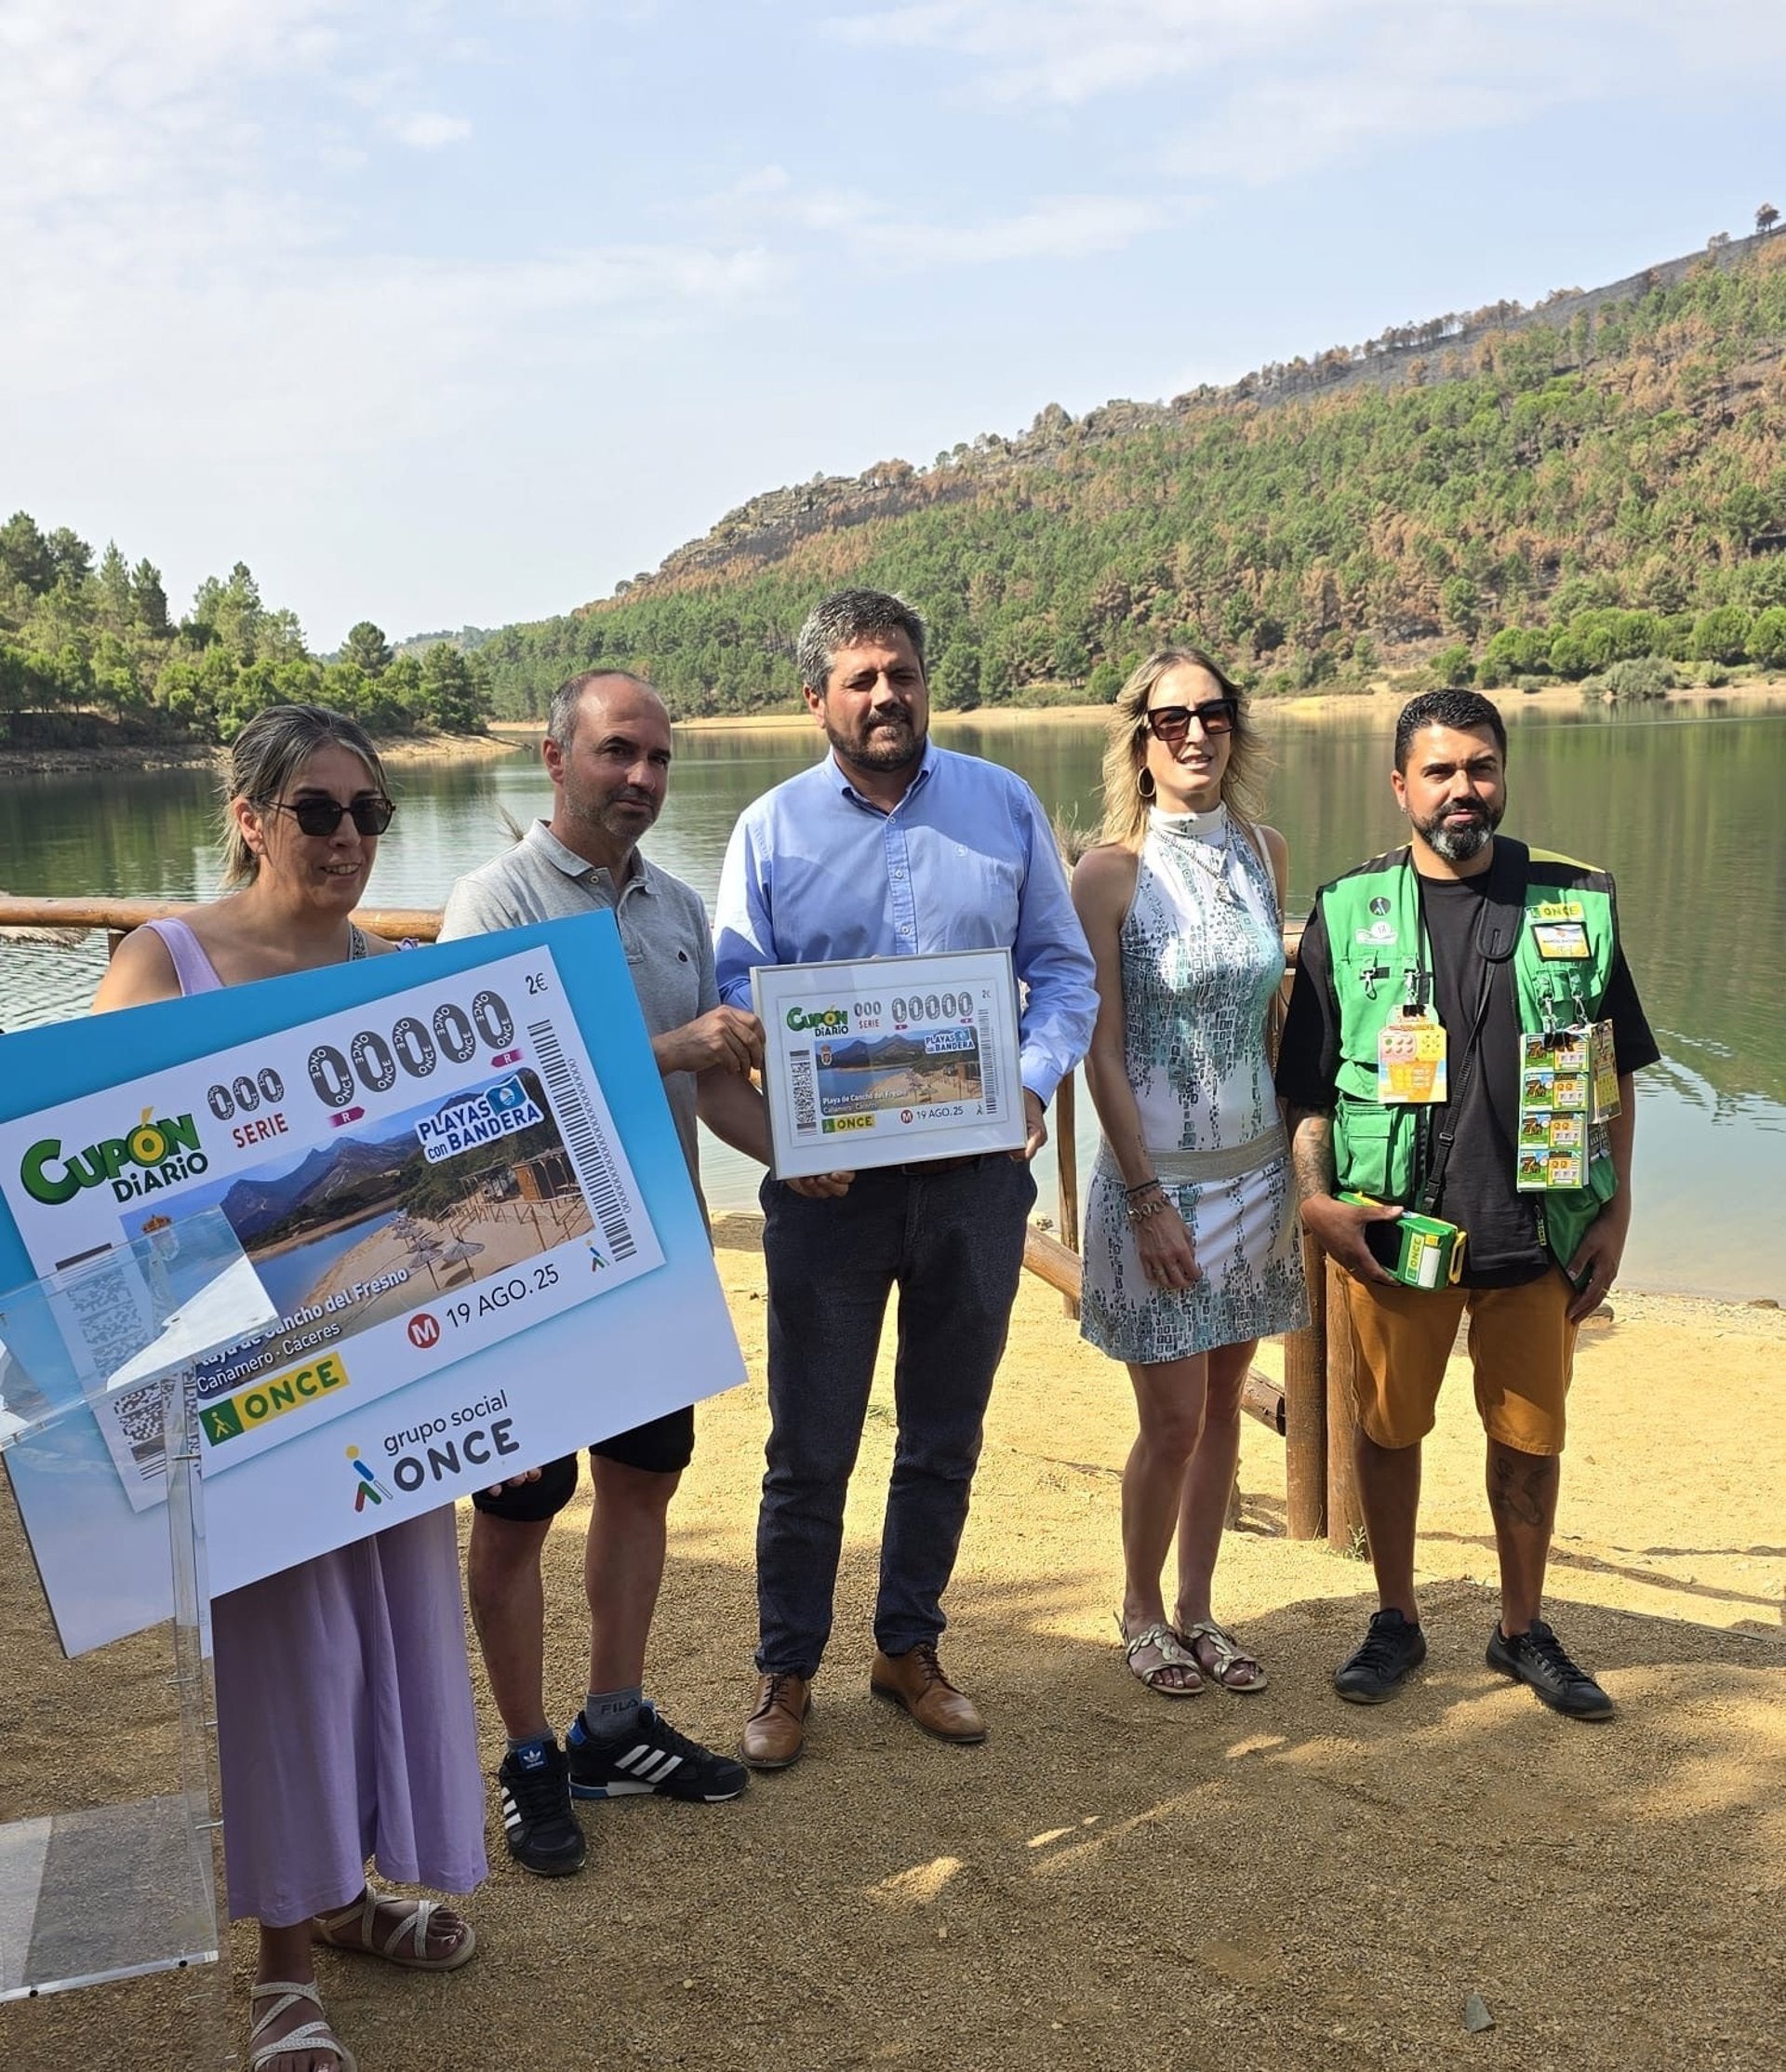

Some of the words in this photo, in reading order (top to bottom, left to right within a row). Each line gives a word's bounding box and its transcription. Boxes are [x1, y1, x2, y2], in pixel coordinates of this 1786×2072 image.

[1544, 905, 1579, 916] ONCE
[525, 972, 549, 996] 2€
[891, 991, 974, 1023] 00000
[859, 1019, 880, 1030] SERIE
[925, 1033, 955, 1045] PLAYAS
[207, 1067, 285, 1121] 000
[307, 990, 515, 1108] 00000
[503, 1053, 513, 1064] R
[935, 1041, 974, 1052] BANDERA
[232, 1112, 288, 1148] SERIE
[340, 1112, 352, 1123] R
[418, 1099, 491, 1142] PLAYAS
[428, 1143, 448, 1160] con
[447, 1103, 541, 1152] BANDERA
[837, 1116, 873, 1130] ONCE
[1410, 1237, 1422, 1267] ONCE
[326, 1288, 353, 1314] del
[352, 1268, 408, 1301] Fresno
[410, 1317, 438, 1345] M
[446, 1303, 471, 1328] 19
[196, 1349, 273, 1393] Cañamero
[282, 1322, 341, 1356] Cáceres
[245, 1359, 340, 1420] ONCE
[383, 1417, 446, 1457] grupo
[450, 1388, 508, 1427] social
[393, 1417, 520, 1492] ONCE
